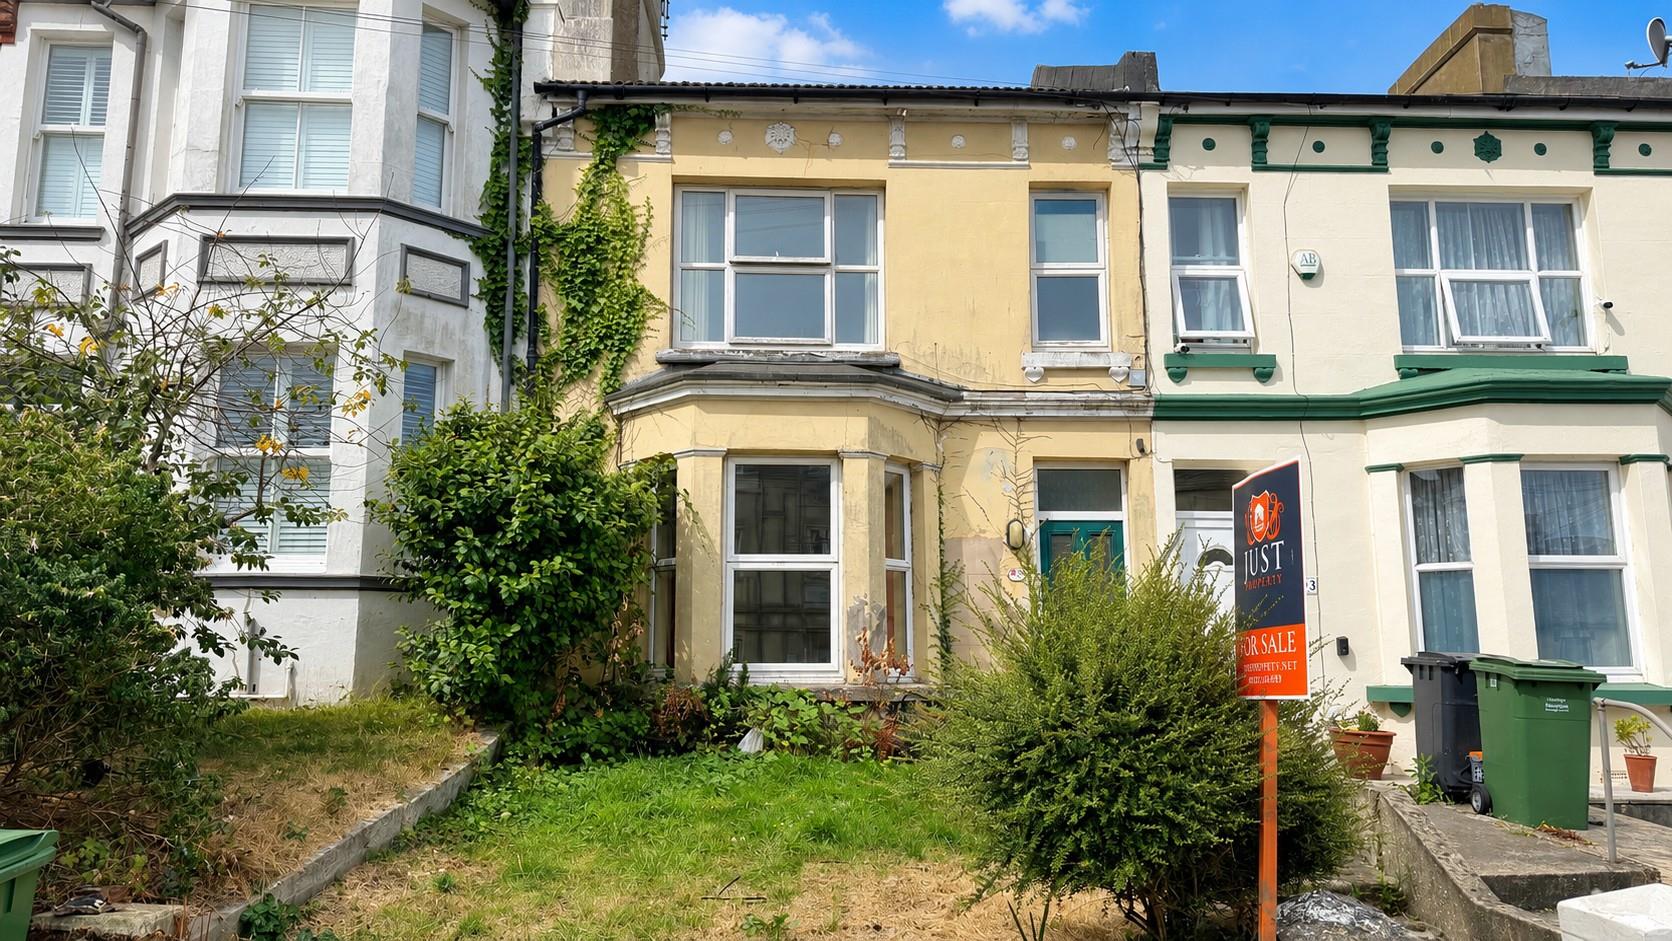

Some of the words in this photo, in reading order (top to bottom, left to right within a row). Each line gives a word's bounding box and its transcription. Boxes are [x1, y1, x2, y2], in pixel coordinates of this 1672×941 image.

[1300, 253, 1317, 264] AB
[1243, 541, 1285, 585] JUST
[1261, 630, 1297, 655] SALE
